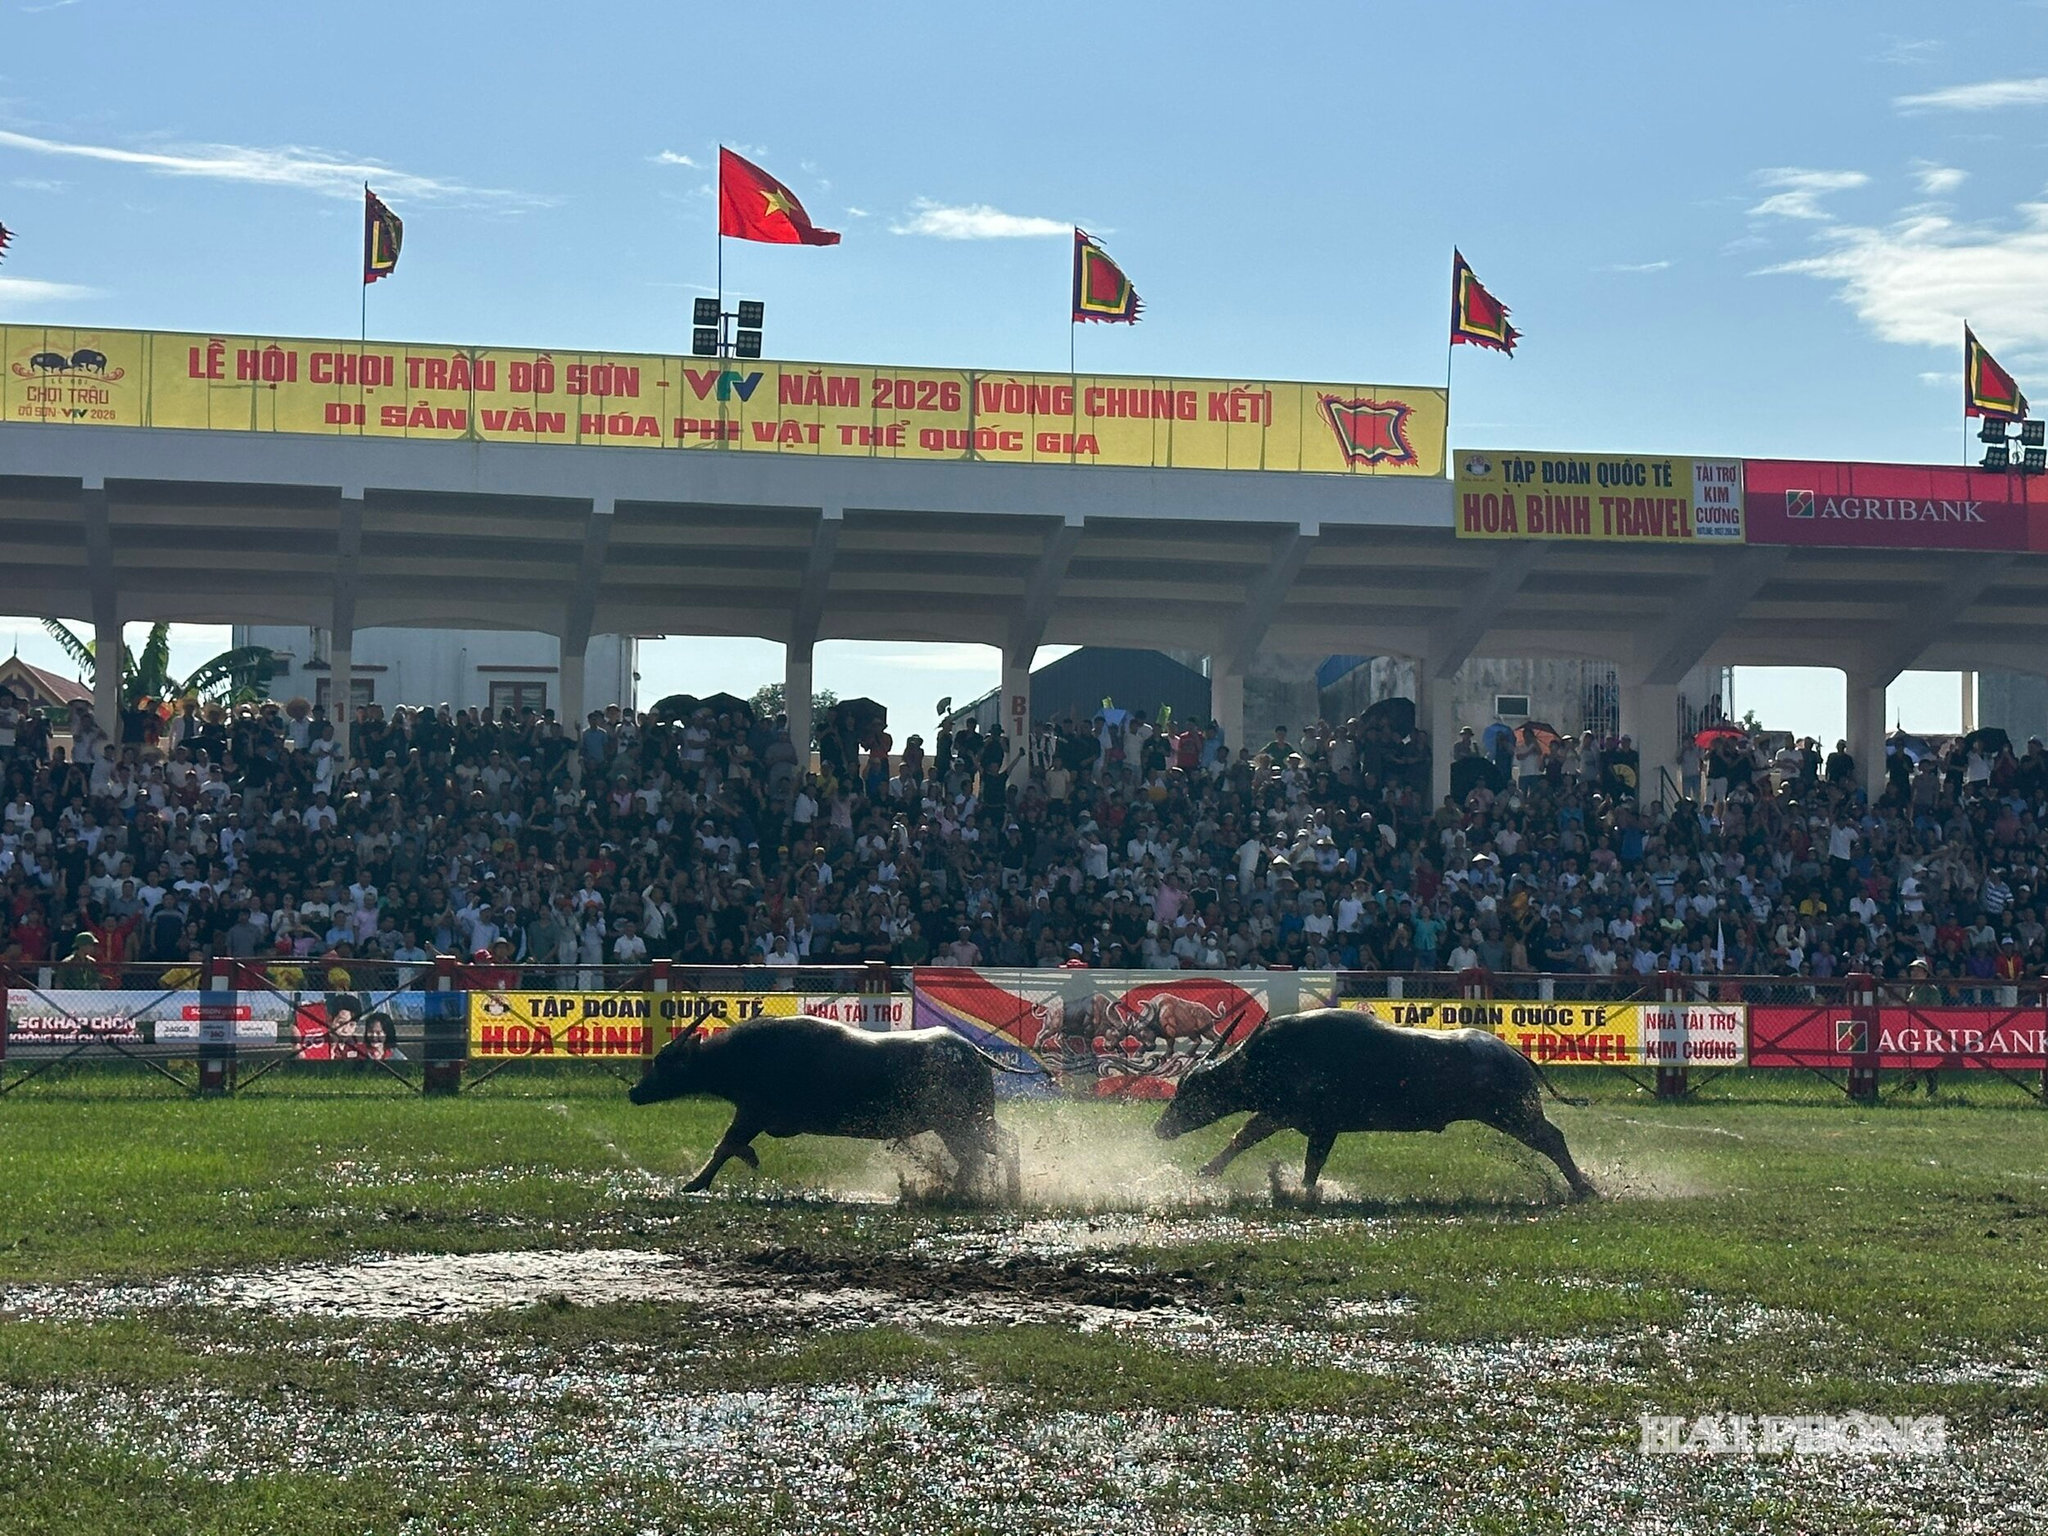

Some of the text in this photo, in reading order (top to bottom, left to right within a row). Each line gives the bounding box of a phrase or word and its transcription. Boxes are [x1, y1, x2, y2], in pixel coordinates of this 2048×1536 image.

[27, 386, 109, 404] CHỌI TRÂU
[189, 338, 225, 380] LỄ
[236, 345, 297, 389] HỘI
[310, 352, 393, 393] CHỌI
[405, 352, 495, 392] TRÂU
[508, 353, 555, 395] ĐỒ
[567, 362, 640, 398] SƠN
[682, 369, 764, 402] VTV
[779, 369, 860, 408] NĂM
[872, 379, 962, 412] 2026
[973, 377, 1074, 417] (VÒNG
[1084, 386, 1197, 421] CHUNG
[1208, 384, 1272, 427] KẾT)
[61, 408, 88, 418] VTV
[91, 409, 116, 419] 2026
[325, 401, 1100, 455] DI SẢN VĂN HÓA PHI VẬT THỂ QUỐC GIA
[1501, 456, 1673, 488] TẬP ĐOÀN QUỐC TẾ
[1696, 462, 1736, 486] TÀI TRỢ
[1704, 486, 1729, 503] KIM
[1463, 488, 1692, 537] HOÀ BÌNH TRAVEL
[1696, 506, 1739, 524] CƯƠNG
[1821, 497, 1986, 523] AGRIBANK
[90, 1009, 136, 1029] CHỐN
[528, 995, 764, 1021] TẬP ĐOÀN QUỐC TẾ
[805, 1000, 903, 1026] NHÀ TÀI TRỢ
[1391, 1003, 1607, 1027] TẬP ĐOÀN QUỐC TẾ
[1646, 1009, 1736, 1034] NHÀ TÀI TRỢ
[9, 1031, 52, 1043] KHÔNG
[481, 1022, 555, 1055] HOÀ
[567, 1021, 653, 1055] BÌNH
[1517, 1034, 1630, 1061] TRAVEL
[1646, 1039, 1736, 1059] KIM CƯƠNG
